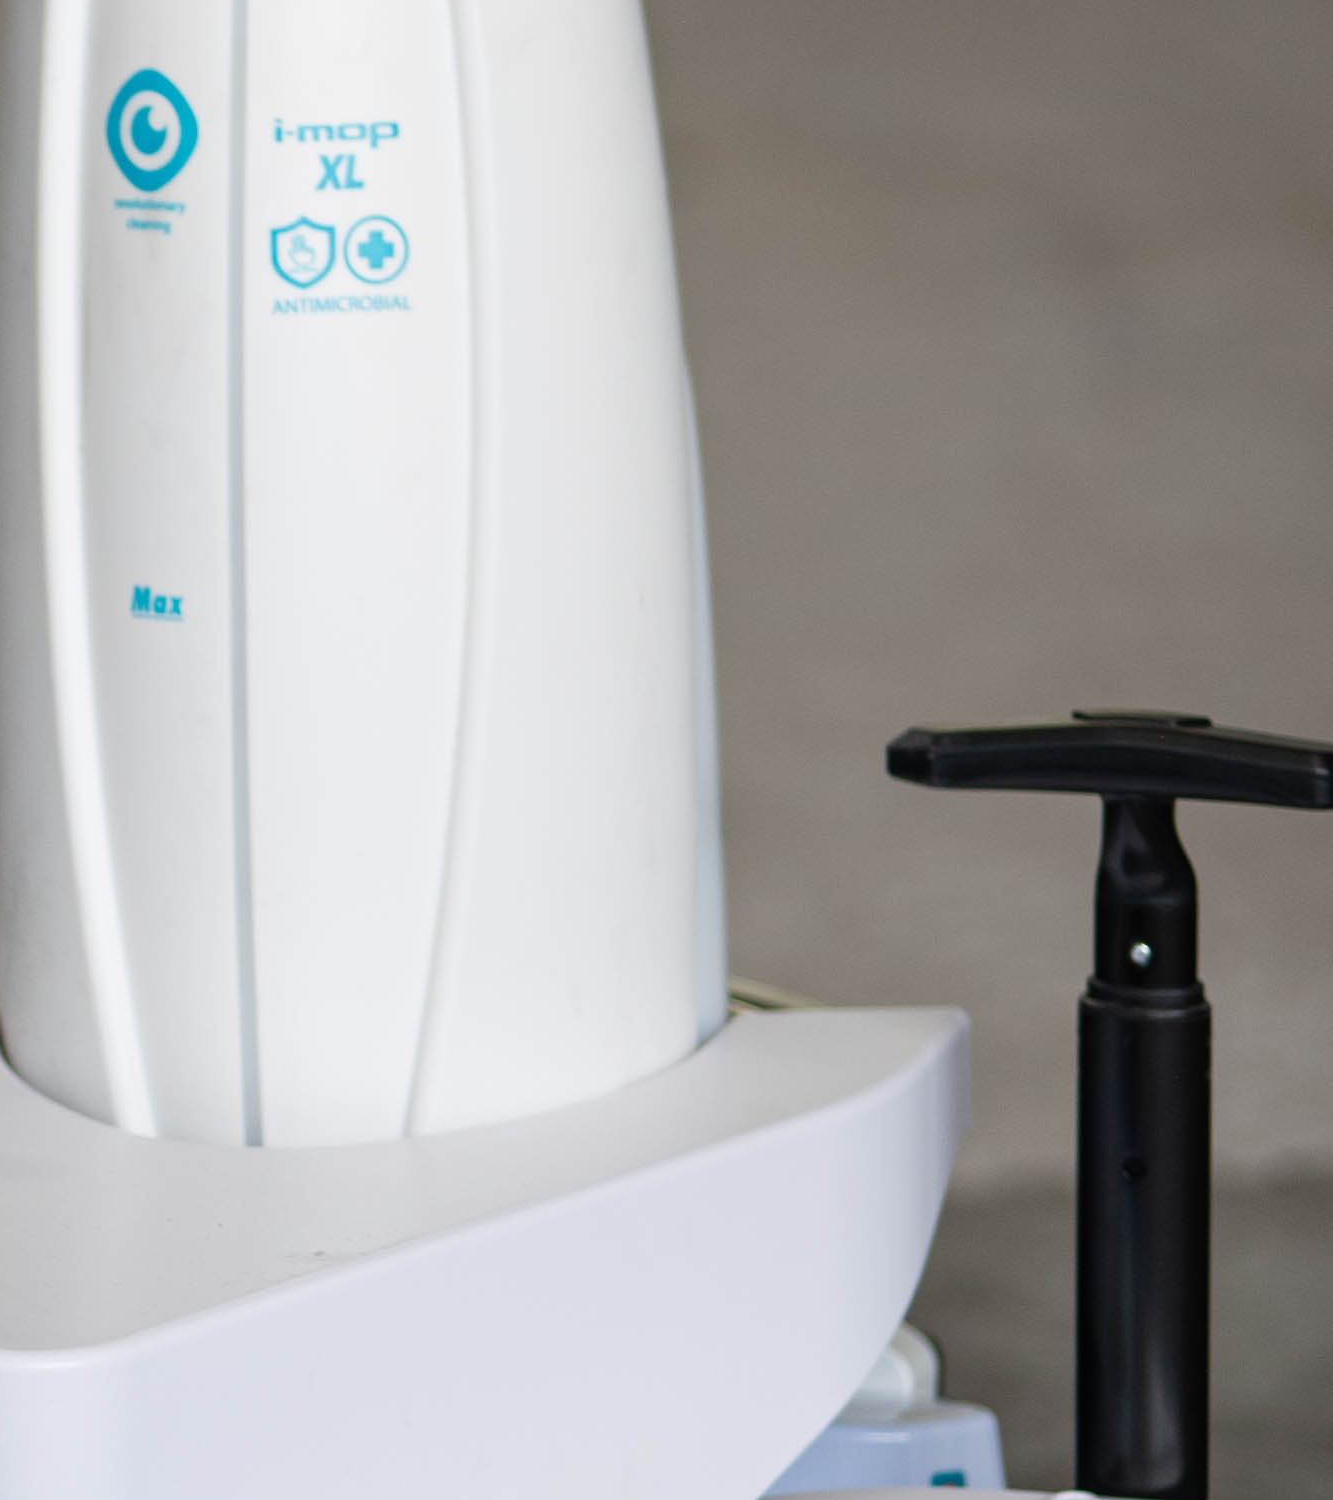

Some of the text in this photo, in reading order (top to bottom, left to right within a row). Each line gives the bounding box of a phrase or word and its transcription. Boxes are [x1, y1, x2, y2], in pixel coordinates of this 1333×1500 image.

[273, 117, 400, 149] i-mop
[316, 154, 365, 190] XL
[271, 295, 414, 314] ANTIMICROBIAL
[131, 584, 183, 616] Max
